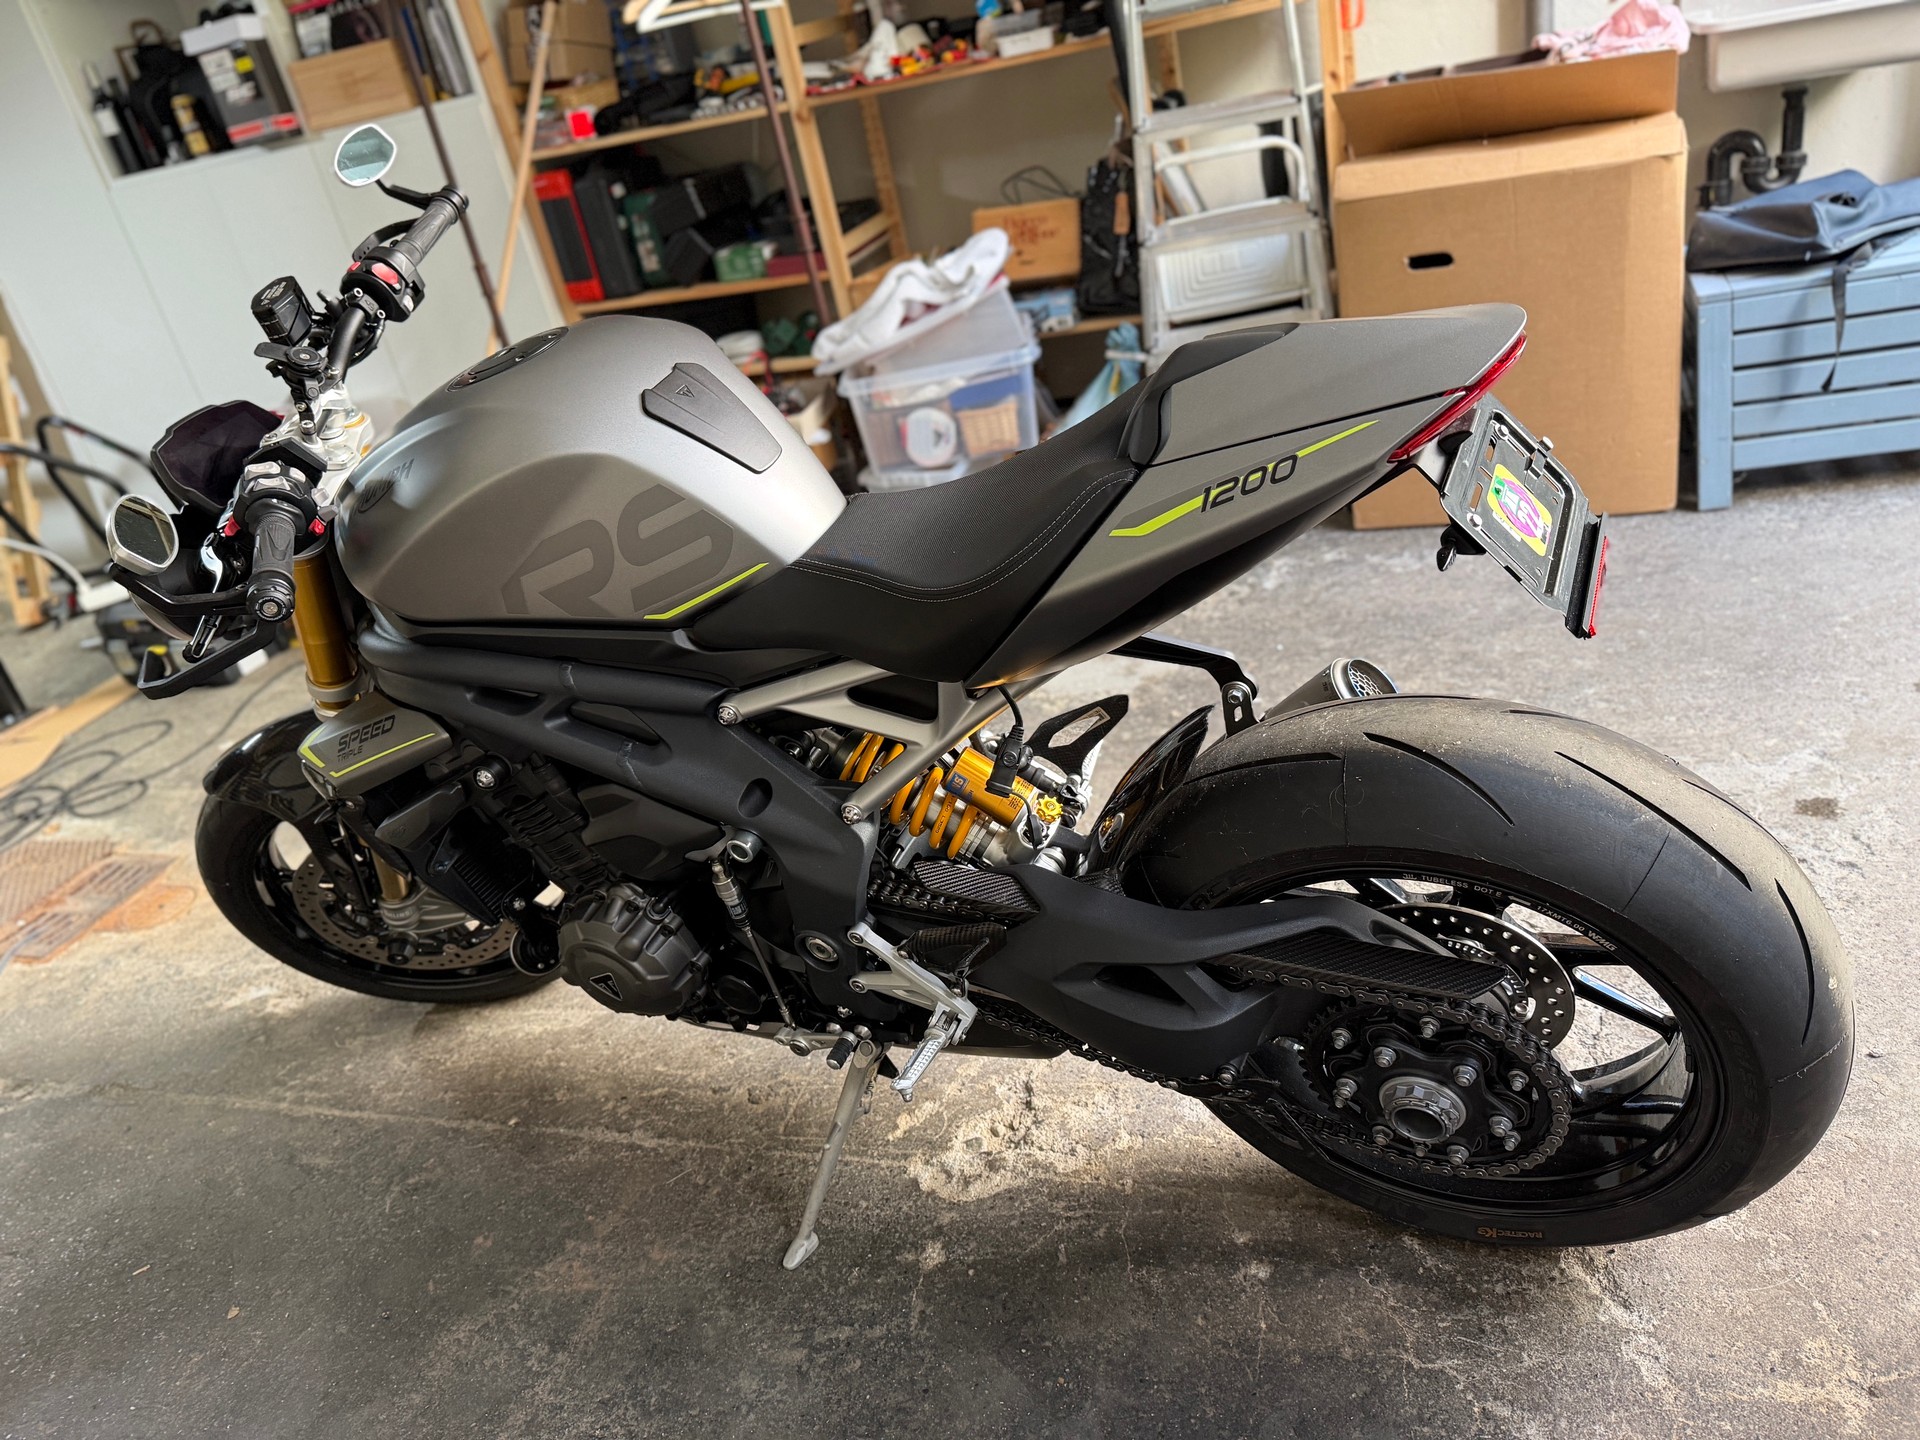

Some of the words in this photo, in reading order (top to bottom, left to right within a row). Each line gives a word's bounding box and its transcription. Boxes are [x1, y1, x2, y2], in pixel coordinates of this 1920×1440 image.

[1201, 454, 1298, 513] 1200
[501, 483, 734, 619] RS
[337, 714, 396, 754] SPEED
[337, 744, 363, 762] TRIPLE
[1421, 874, 1469, 889] TUBELESS
[1474, 884, 1494, 896] DOT
[1497, 1229, 1543, 1239] RACETEC
